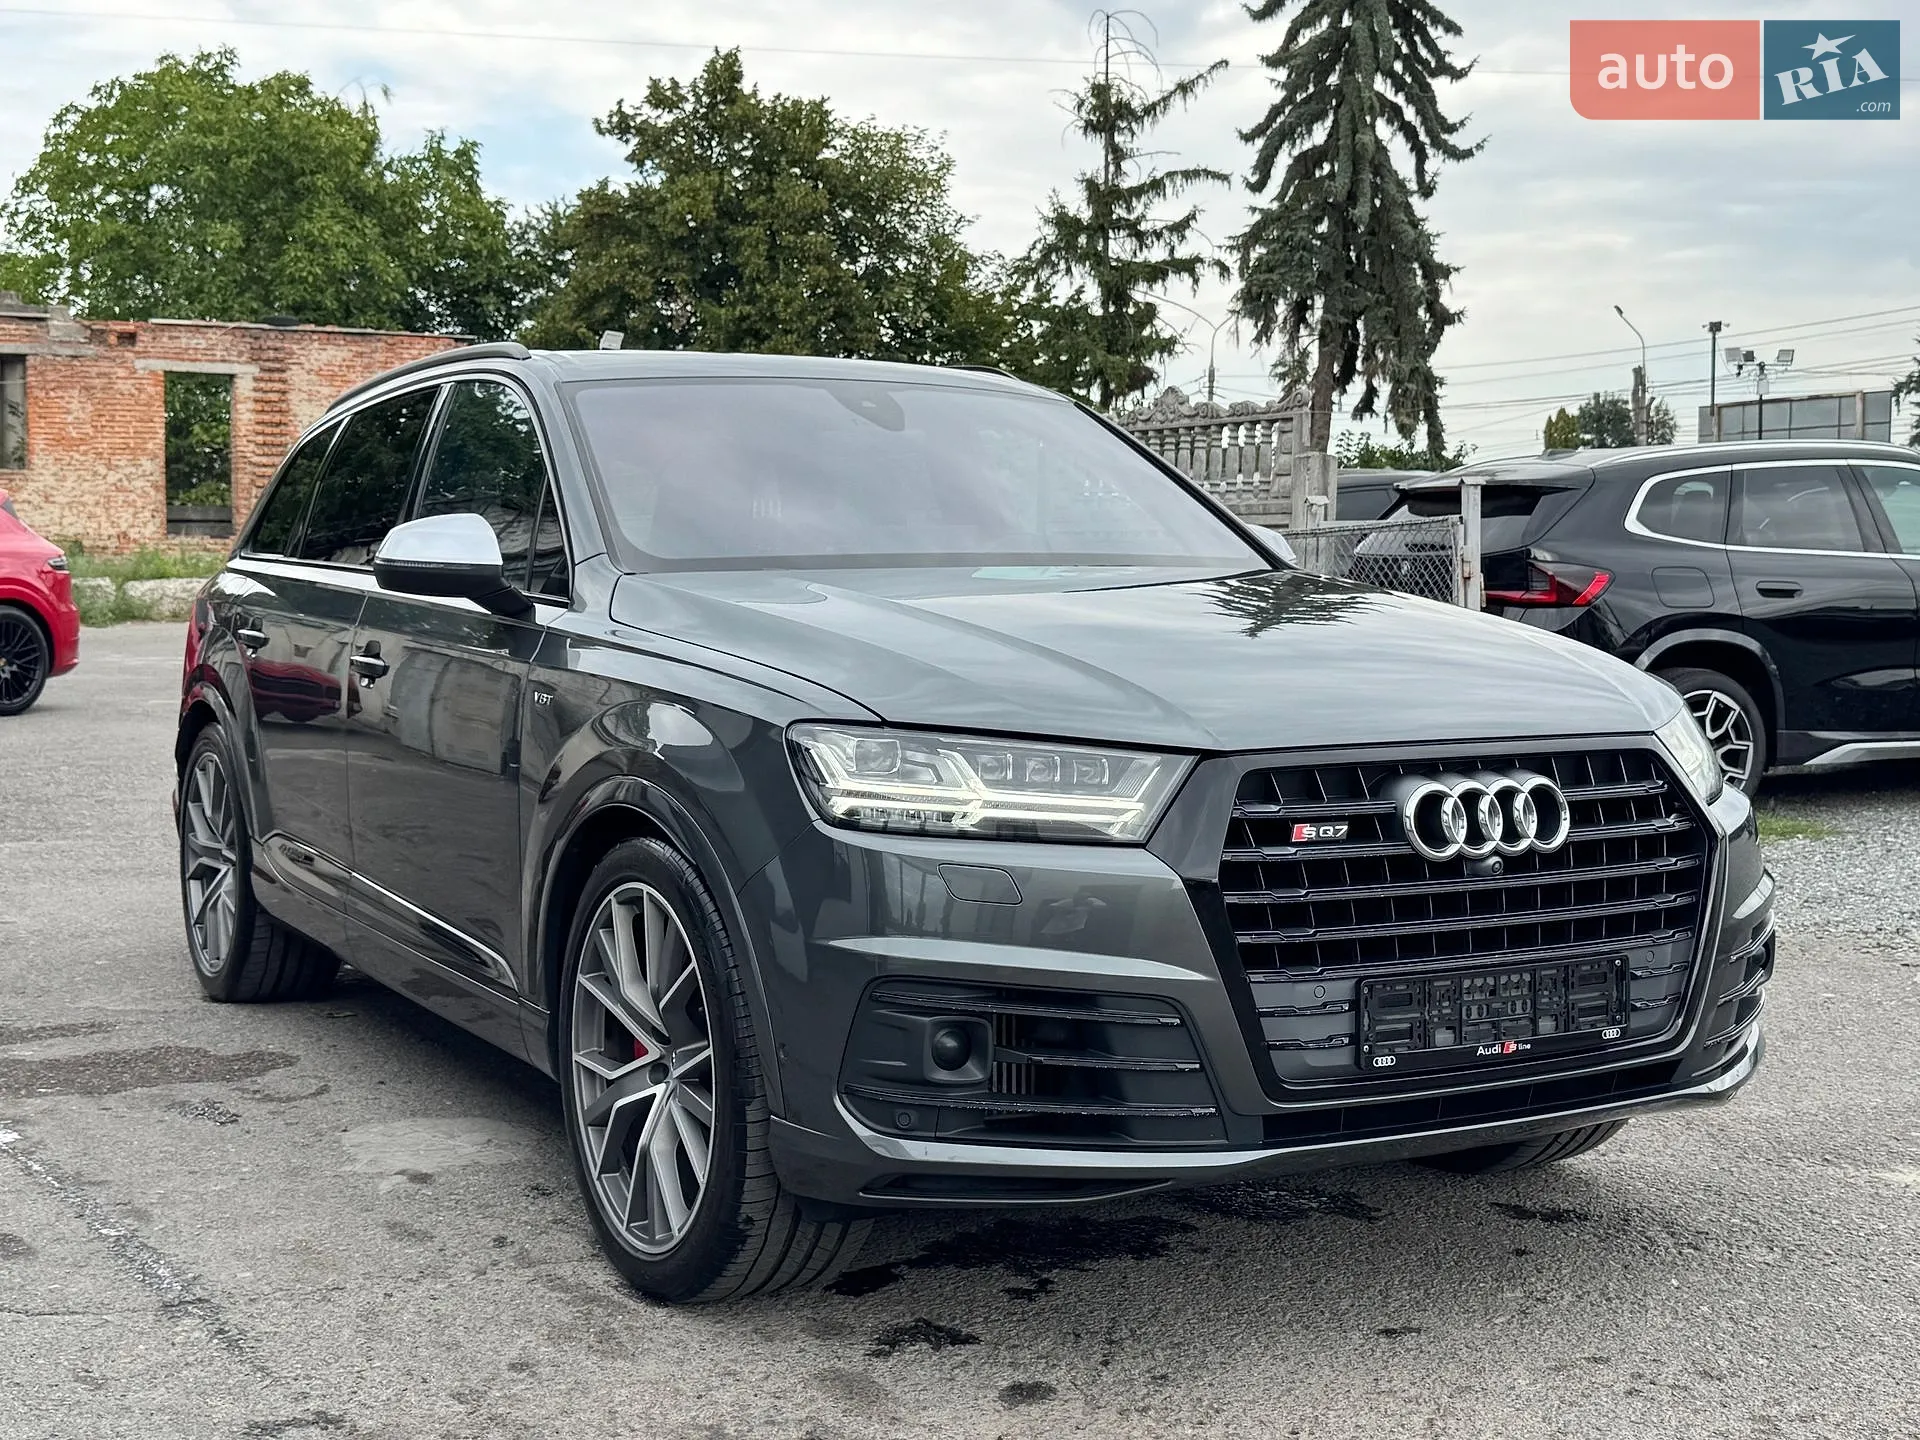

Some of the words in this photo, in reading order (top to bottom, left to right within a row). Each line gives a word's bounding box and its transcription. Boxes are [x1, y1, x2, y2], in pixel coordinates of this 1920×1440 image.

[1292, 823, 1349, 841] SQ7
[1476, 1043, 1502, 1056] Audi
[1518, 1042, 1531, 1051] line
